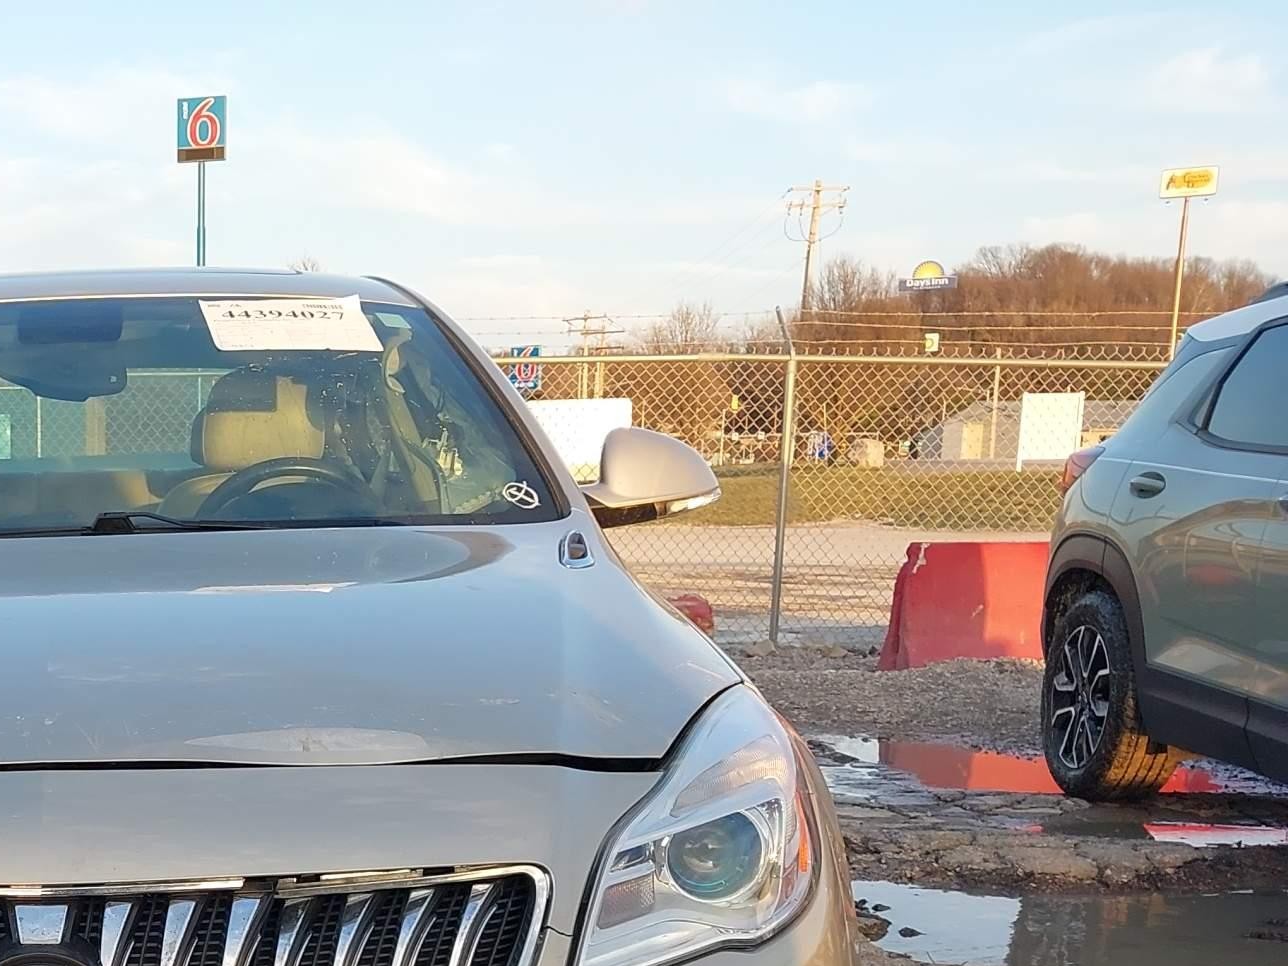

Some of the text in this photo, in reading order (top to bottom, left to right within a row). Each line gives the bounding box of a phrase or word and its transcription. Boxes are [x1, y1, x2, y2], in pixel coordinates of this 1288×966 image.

[187, 97, 220, 148] 6
[905, 279, 931, 288] Days
[932, 277, 950, 286] Inn
[221, 309, 345, 321] 44394027
